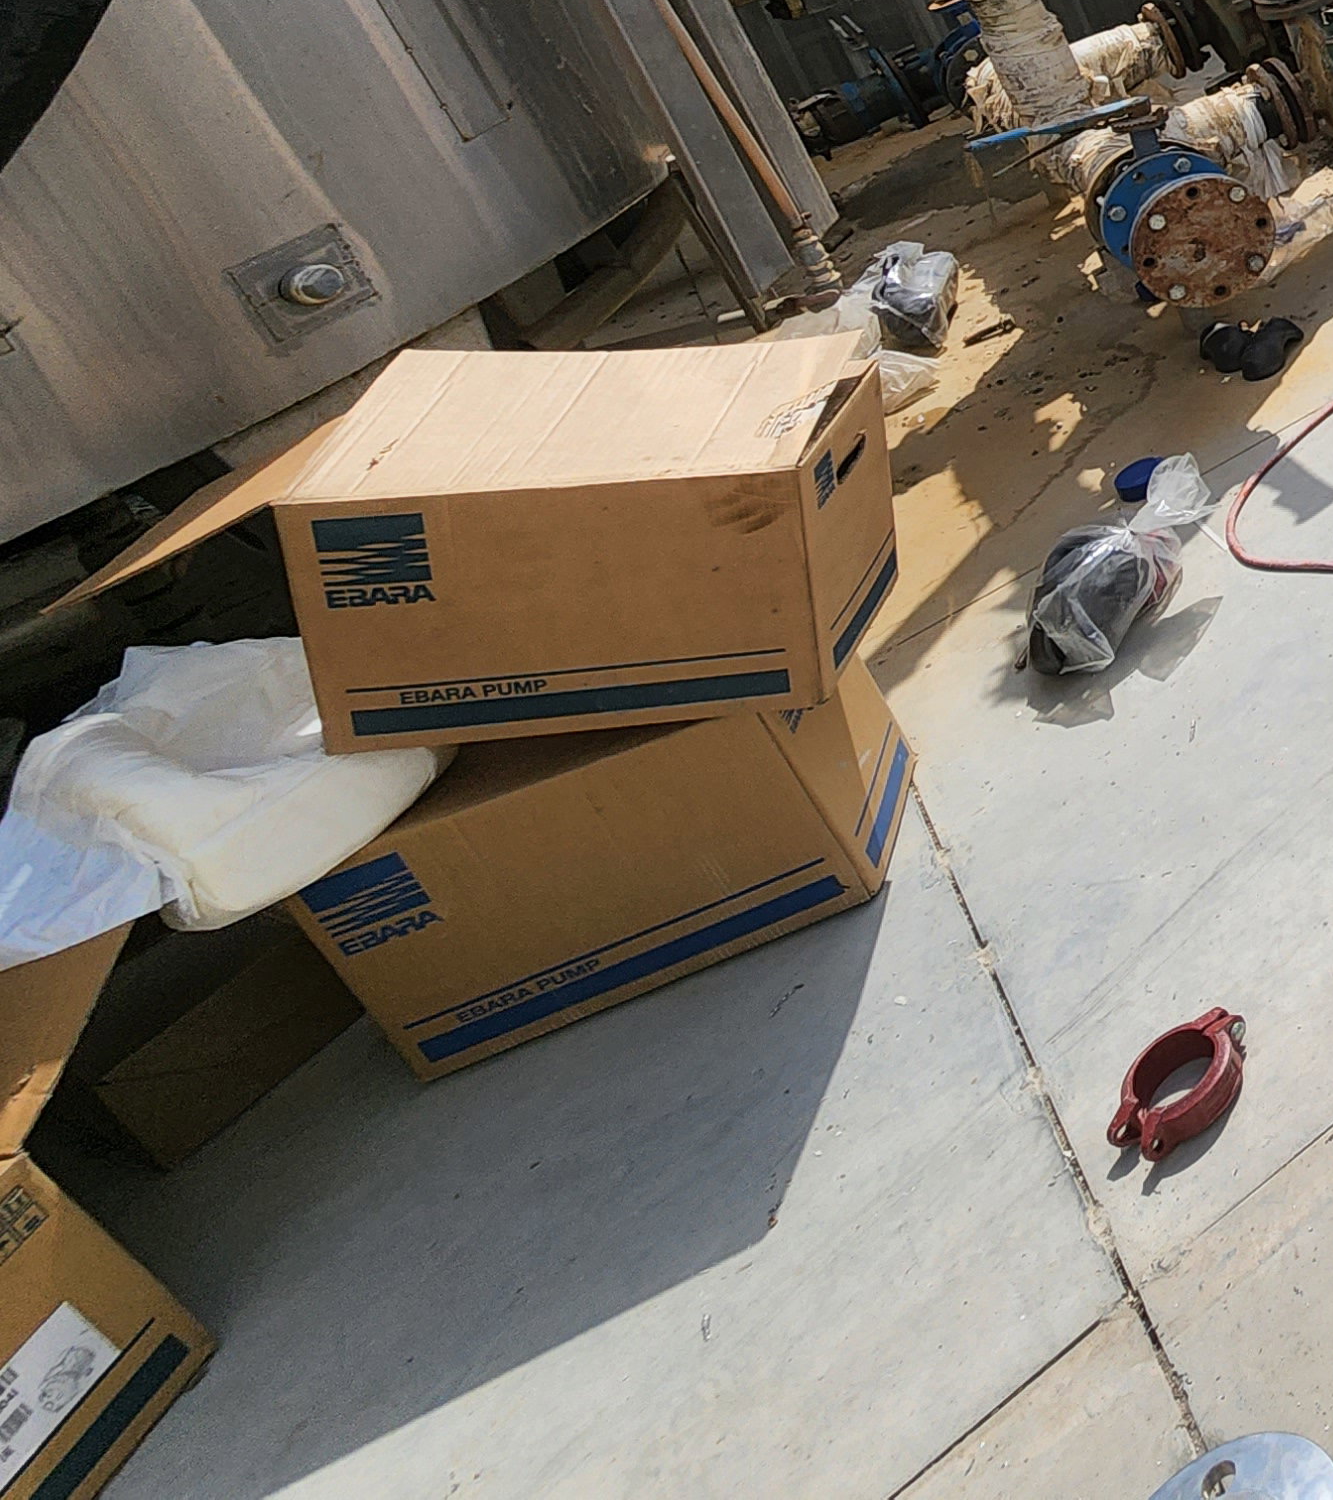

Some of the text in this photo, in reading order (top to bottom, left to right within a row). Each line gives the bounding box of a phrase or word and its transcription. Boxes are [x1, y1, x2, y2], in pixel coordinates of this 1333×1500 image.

[324, 583, 437, 610] EBARA
[399, 679, 548, 705] EBARA PUMP
[337, 910, 445, 957] EBARA
[455, 958, 601, 1023] EBARA PUMP
